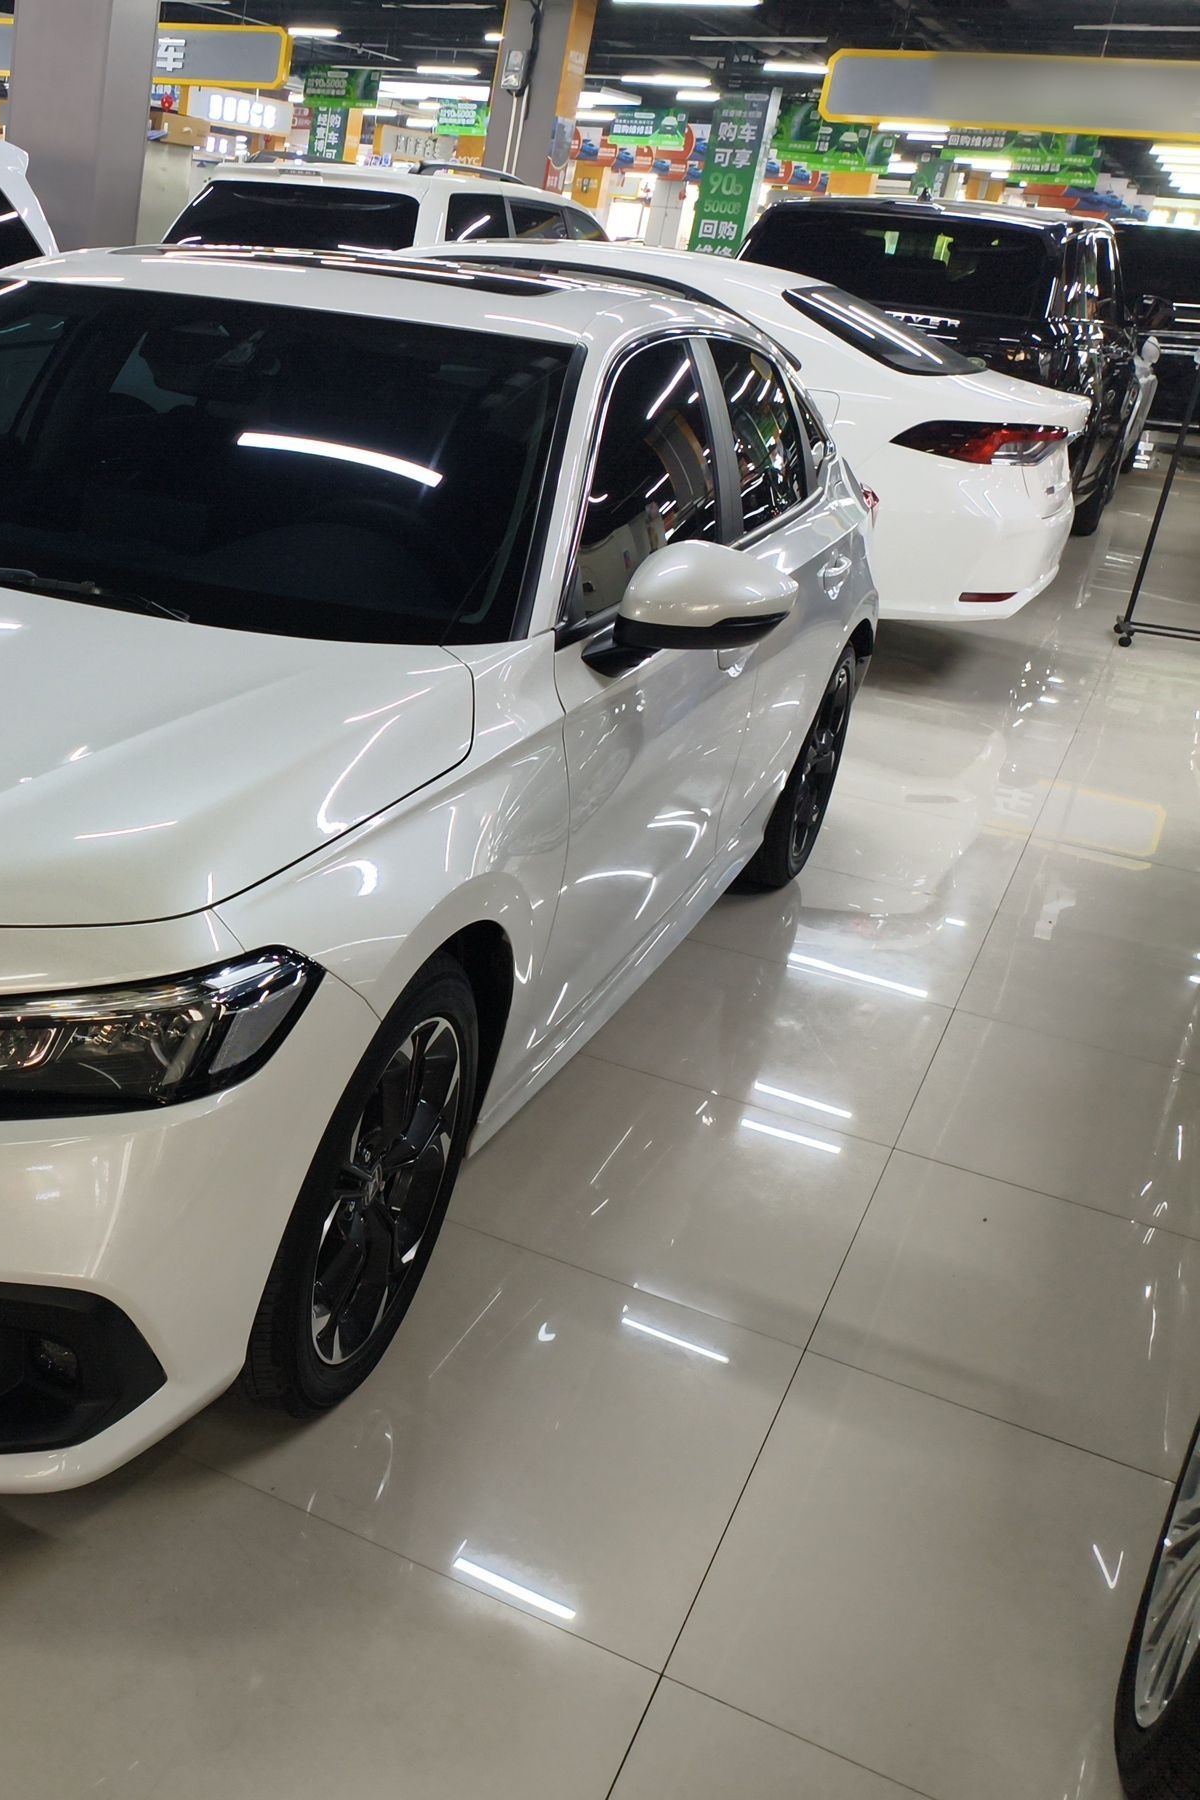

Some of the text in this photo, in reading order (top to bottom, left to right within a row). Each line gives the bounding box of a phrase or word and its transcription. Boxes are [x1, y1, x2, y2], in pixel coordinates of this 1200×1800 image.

[314, 106, 328, 156] 经查博
[326, 106, 341, 160] 购车可
[717, 121, 757, 142] 购车
[458, 155, 481, 165] MYC
[714, 148, 753, 169] 可享
[698, 219, 738, 241] 回购
